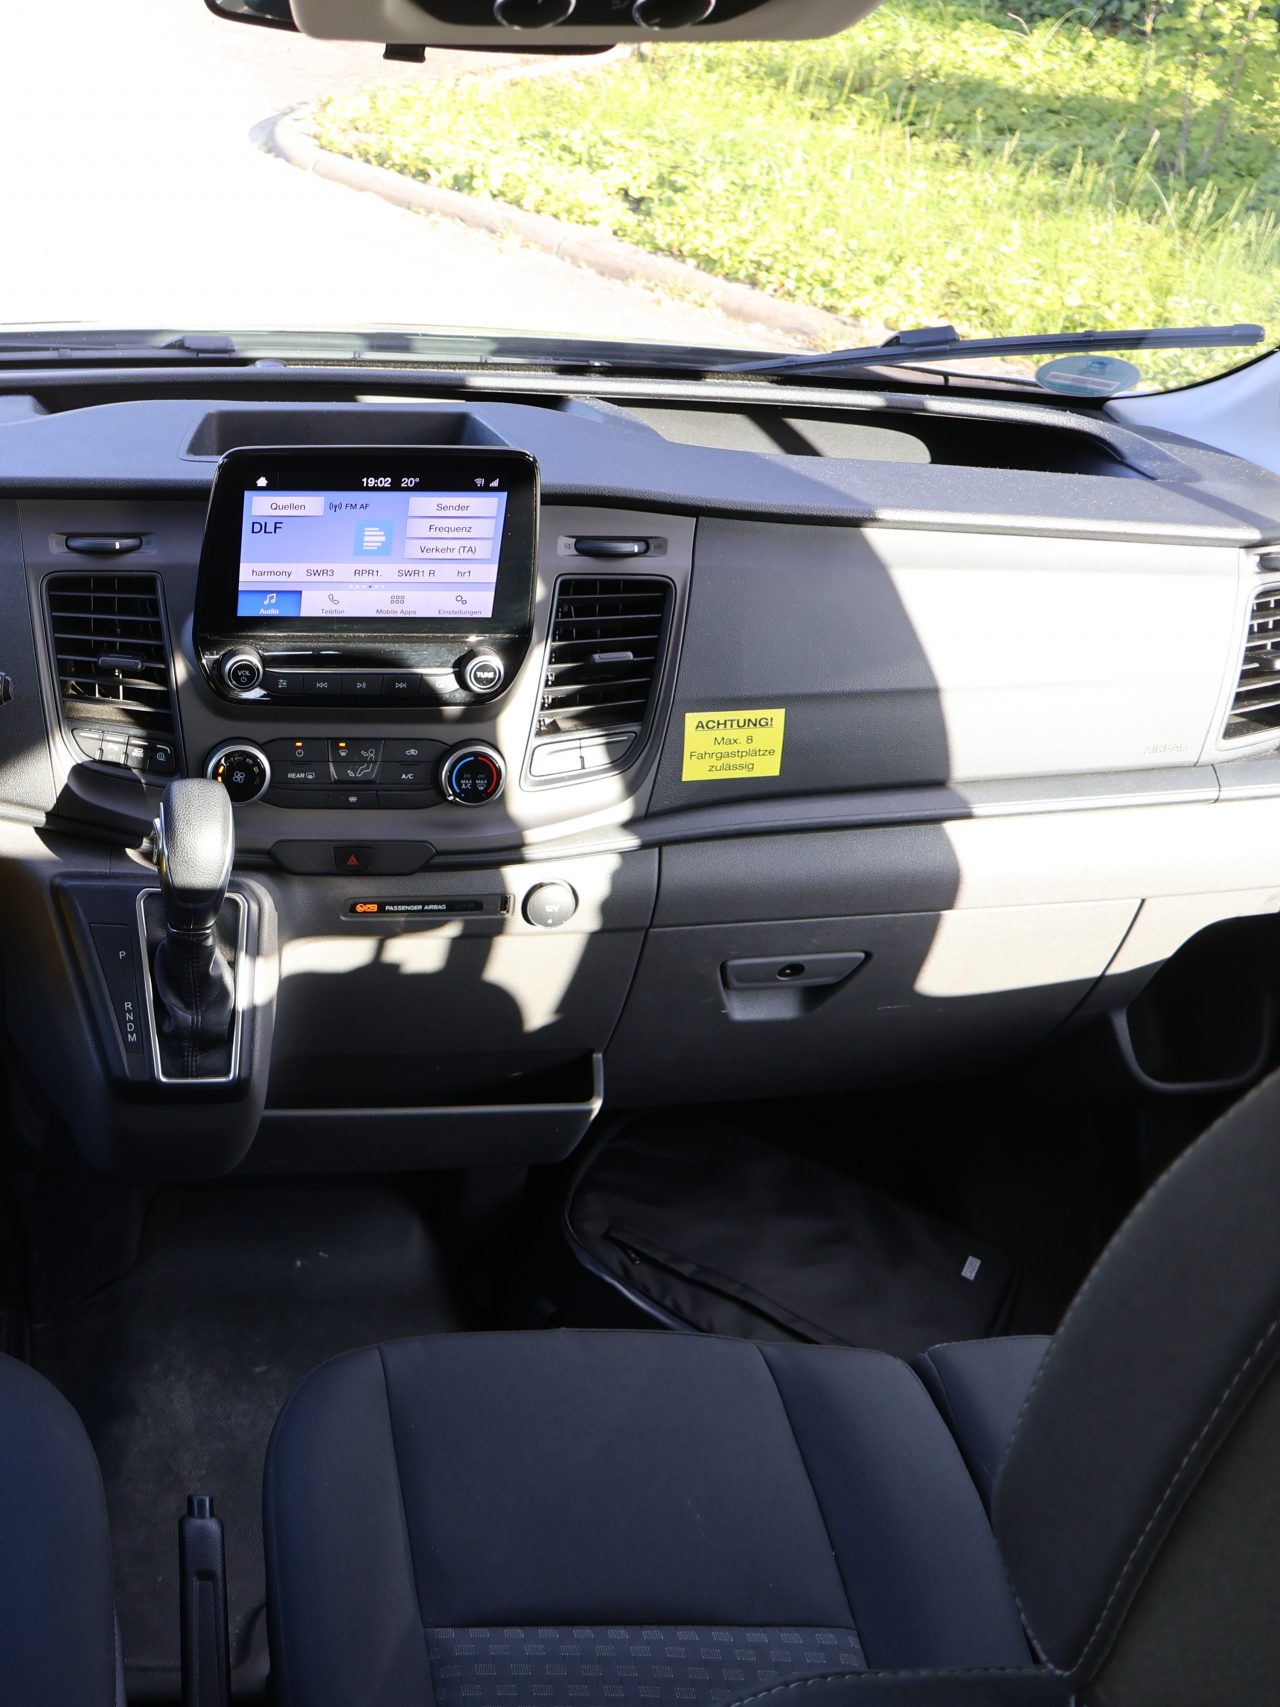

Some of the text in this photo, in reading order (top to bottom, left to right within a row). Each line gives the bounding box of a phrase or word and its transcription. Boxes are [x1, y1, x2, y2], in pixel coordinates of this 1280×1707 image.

[361, 477, 420, 488] 19:02 20°
[270, 502, 306, 512] Quellen
[436, 503, 470, 512] Sender
[251, 521, 283, 535] DLF
[428, 524, 472, 535] Frequenz
[420, 545, 477, 556] Verkehr (TA)
[251, 568, 293, 579] harmony
[306, 568, 335, 577] SWR3
[353, 568, 383, 577] RPR1.
[397, 568, 436, 577] SWR1 R
[457, 568, 472, 578] hr1
[399, 608, 417, 616] Apps
[438, 608, 482, 617] Einstellungen
[476, 671, 495, 679] TUNE
[695, 717, 773, 730] ACHTUNG!
[713, 735, 754, 746] Max. 8
[689, 748, 776, 762] Fahrgastplätze
[707, 762, 755, 773] zulässig
[424, 903, 447, 911] AIRBAG
[119, 951, 126, 960] P
[124, 1001, 133, 1011] R
[126, 1012, 134, 1021] N
[127, 1023, 135, 1031] D
[127, 1033, 137, 1042] M
